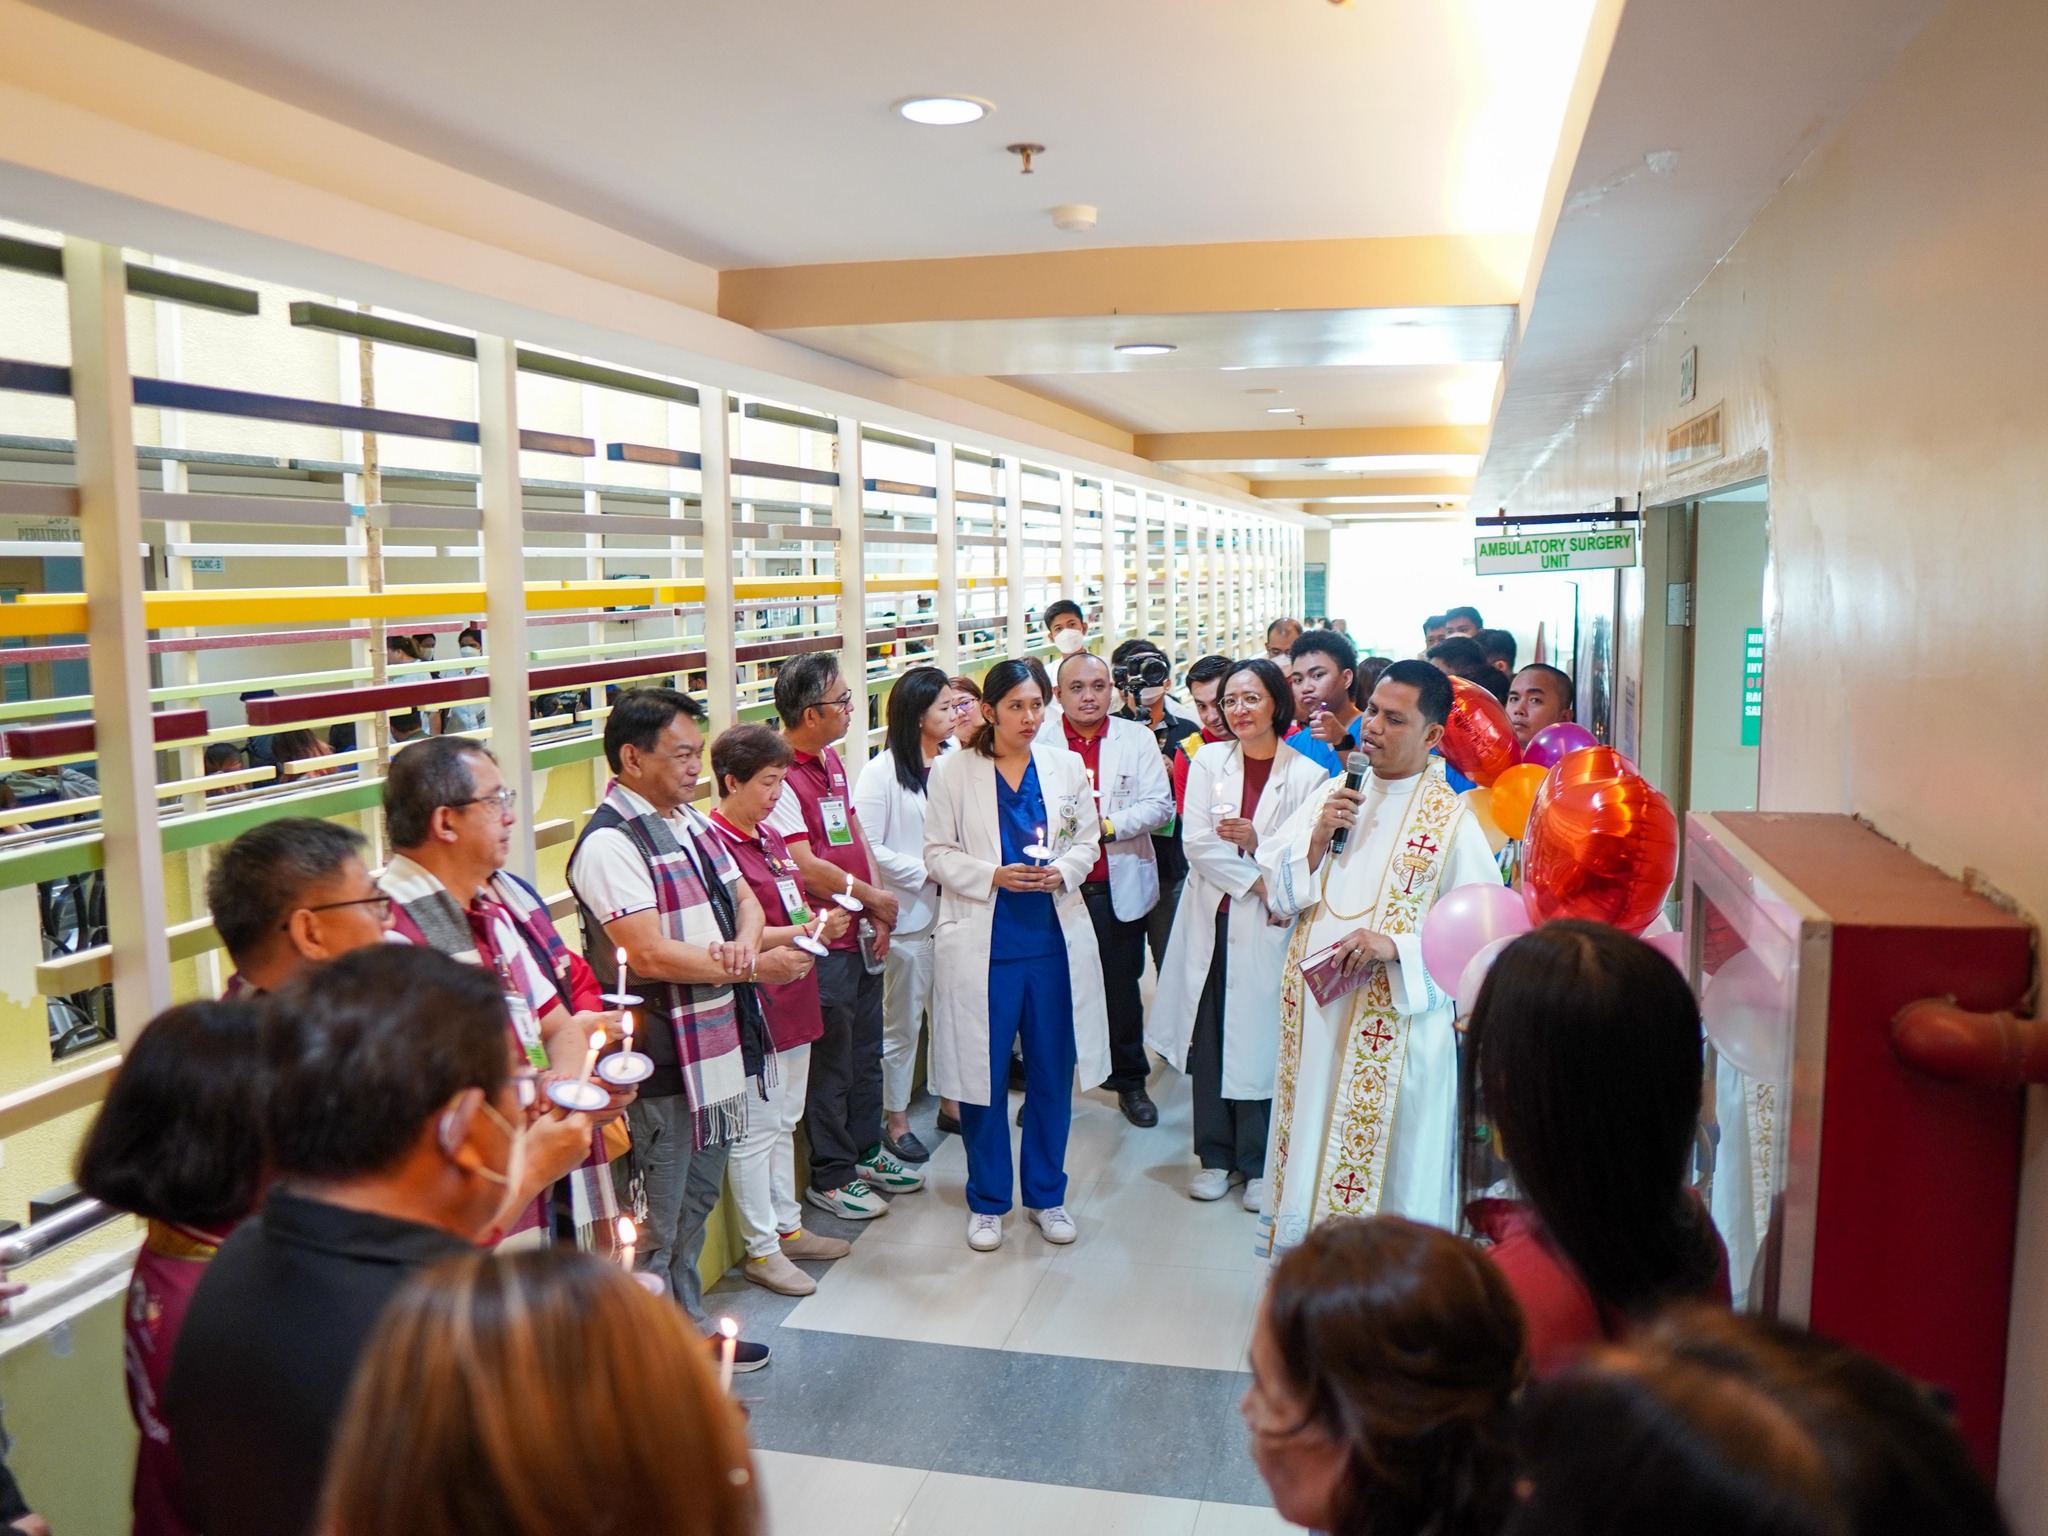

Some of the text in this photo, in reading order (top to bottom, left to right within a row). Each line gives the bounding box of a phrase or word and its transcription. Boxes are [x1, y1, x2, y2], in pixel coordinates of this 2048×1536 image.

[1479, 534, 1632, 557] AMBULATORY SURGERY
[1541, 553, 1571, 569] UNIT
